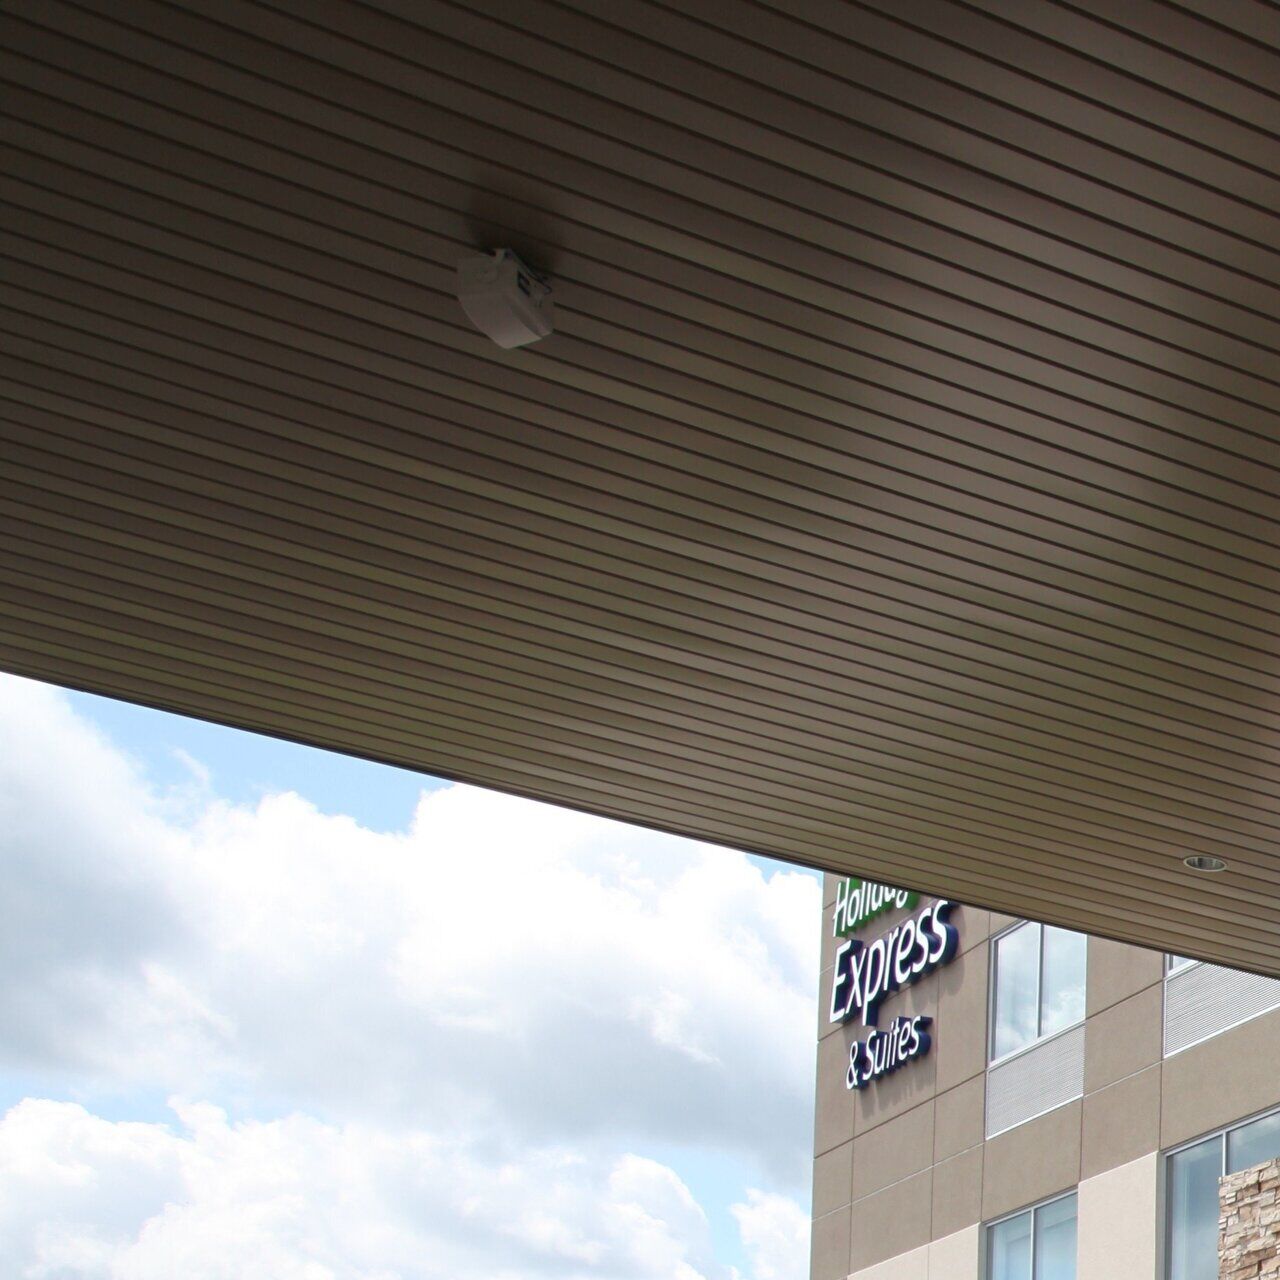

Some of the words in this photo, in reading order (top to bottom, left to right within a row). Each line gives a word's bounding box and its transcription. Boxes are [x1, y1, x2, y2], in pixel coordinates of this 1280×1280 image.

[829, 900, 948, 1026] Express
[846, 1041, 859, 1089] &
[862, 1015, 922, 1081] Suites
